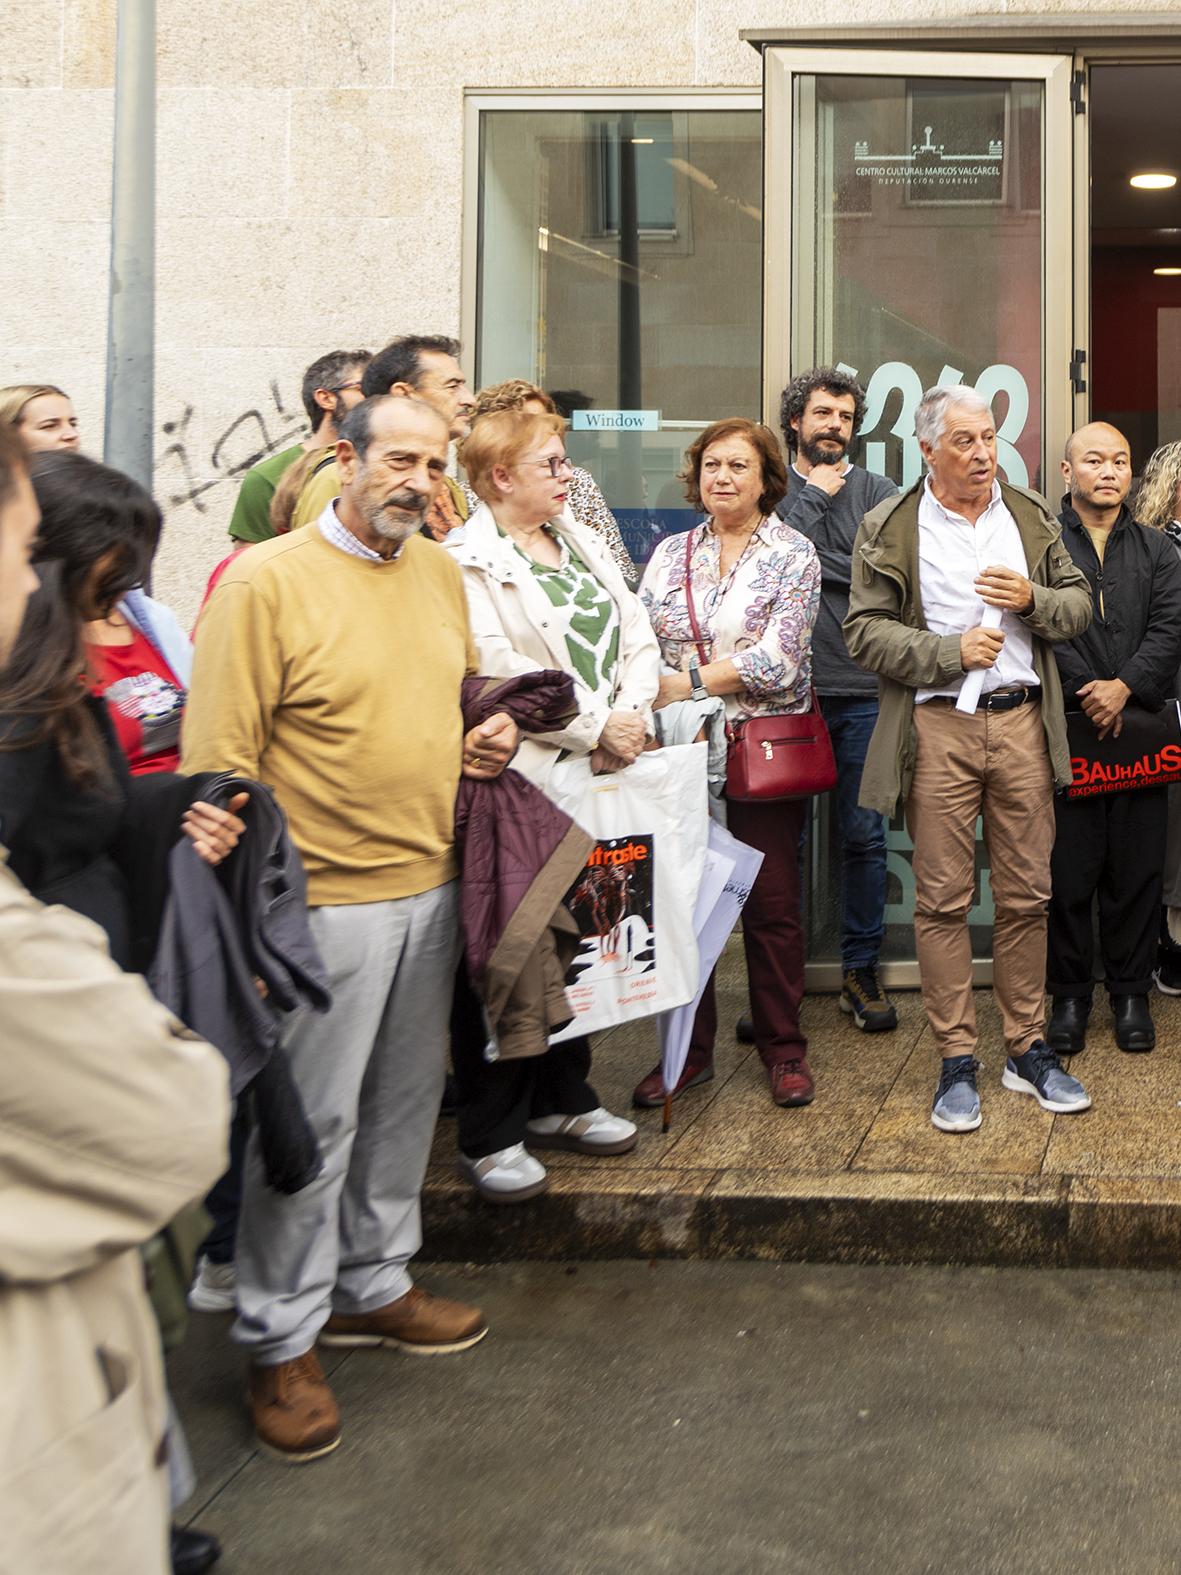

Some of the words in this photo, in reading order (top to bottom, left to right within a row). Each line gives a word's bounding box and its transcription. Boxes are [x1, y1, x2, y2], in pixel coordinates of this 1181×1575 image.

[855, 167, 886, 176] CENTRO
[886, 166, 924, 176] CULTURAL
[924, 166, 957, 176] MARCOS
[939, 177, 979, 185] OURENSE
[586, 413, 646, 427] Window
[616, 517, 667, 530] ESCOLA
